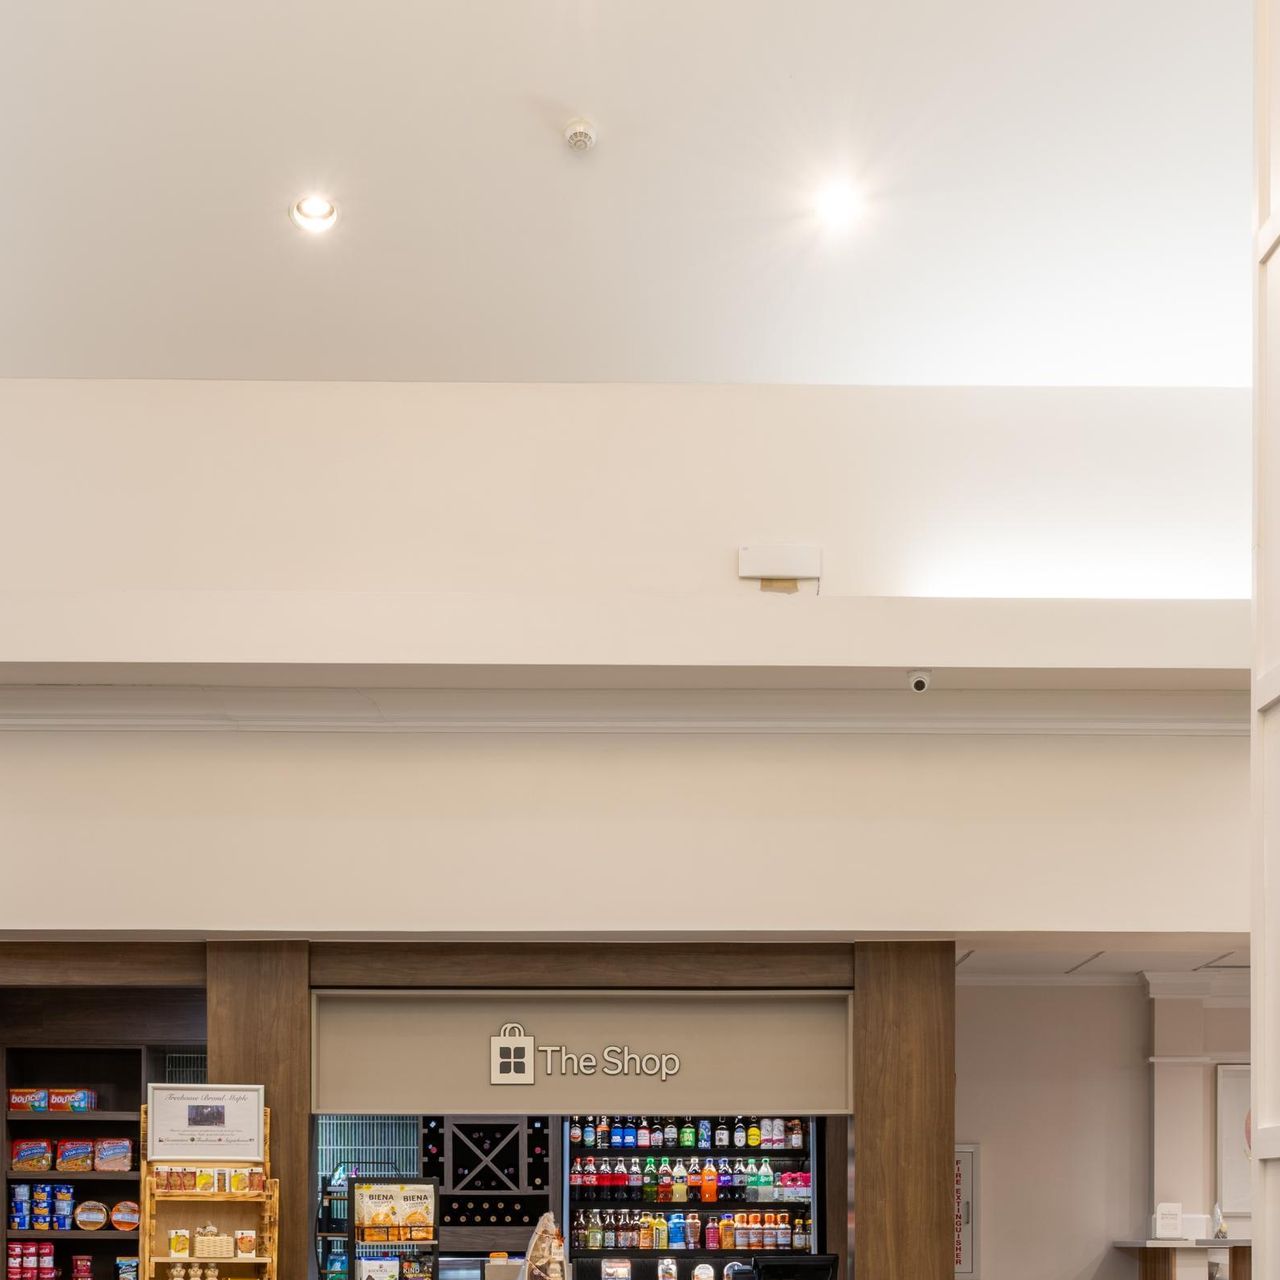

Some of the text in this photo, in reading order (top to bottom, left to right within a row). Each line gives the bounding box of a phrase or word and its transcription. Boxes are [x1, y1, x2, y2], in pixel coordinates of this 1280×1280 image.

[537, 1045, 681, 1082] The Shop
[11, 1093, 40, 1104] bounce
[51, 1093, 81, 1104] bounce
[403, 1194, 428, 1202] BIENA
